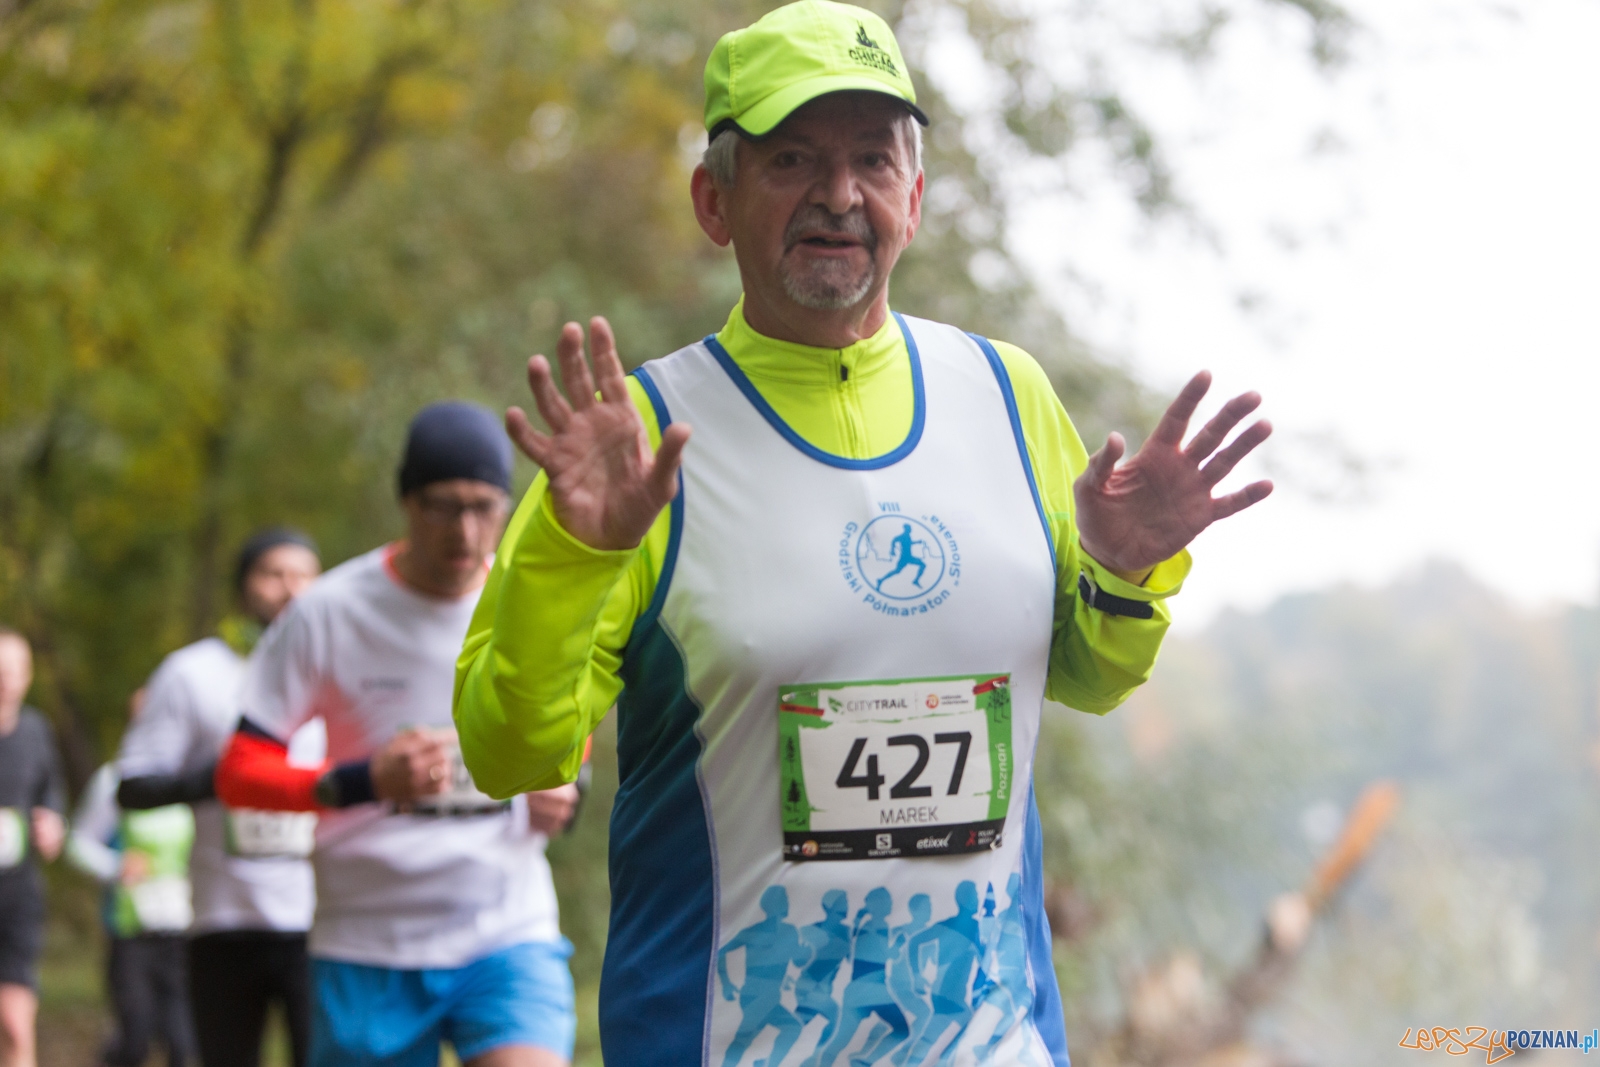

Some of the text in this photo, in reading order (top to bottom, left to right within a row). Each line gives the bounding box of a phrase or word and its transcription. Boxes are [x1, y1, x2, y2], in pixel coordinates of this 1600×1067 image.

[878, 501, 901, 513] VIII
[839, 520, 863, 593] Grodziski
[835, 731, 972, 801] 427
[995, 742, 1008, 800] Poznań
[880, 806, 938, 825] MAREK
